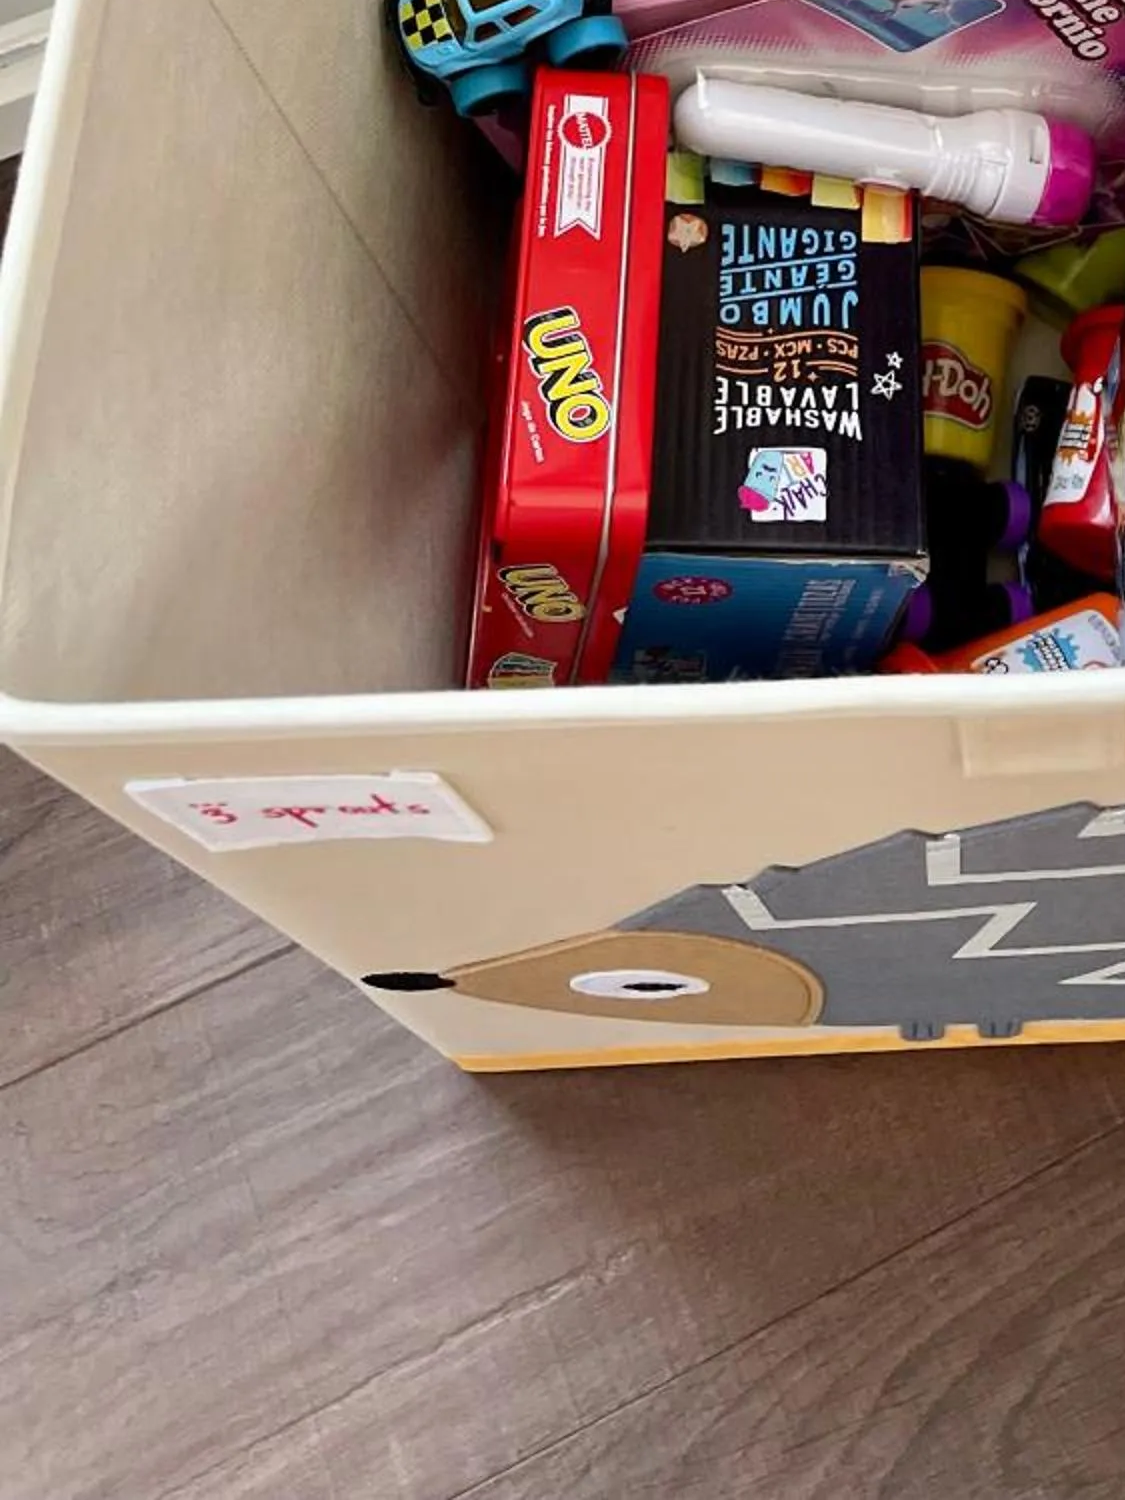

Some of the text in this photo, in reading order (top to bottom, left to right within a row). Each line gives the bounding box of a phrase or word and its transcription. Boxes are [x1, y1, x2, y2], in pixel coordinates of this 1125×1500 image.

[575, 111, 593, 150] MATTEL
[721, 222, 858, 268] GIGANTE
[720, 258, 857, 298] GÉANTE
[720, 290, 859, 329] JUMBO
[715, 340, 760, 362] PZAS
[826, 338, 859, 360] PCS
[525, 305, 611, 440] UNO
[773, 360, 803, 383] 12
[715, 376, 859, 410] LAVABLE
[713, 405, 863, 441] WASHABLE
[498, 564, 588, 623] UNO
[261, 794, 431, 829] sprouts
